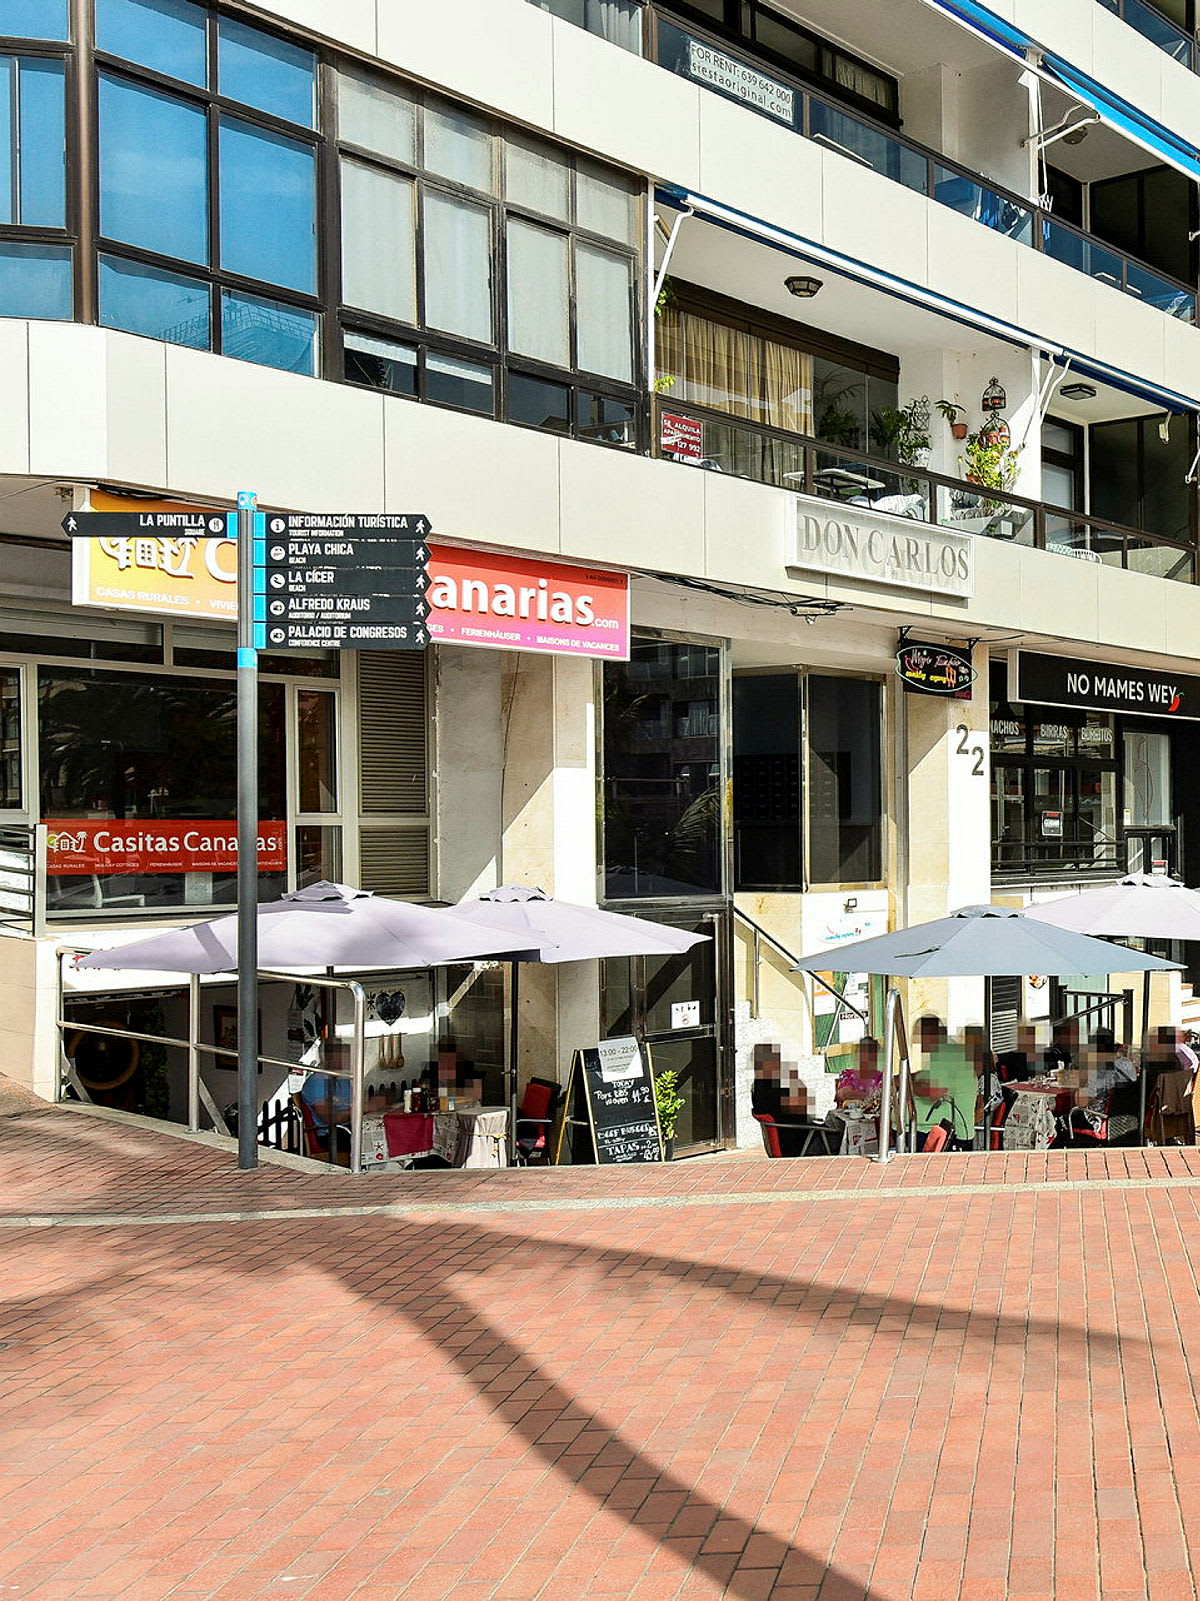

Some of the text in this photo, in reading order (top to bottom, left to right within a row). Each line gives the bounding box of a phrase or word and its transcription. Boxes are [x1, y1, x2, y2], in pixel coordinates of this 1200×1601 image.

[691, 44, 790, 104] FOR RENT: 639 642 000
[692, 61, 791, 117] siestaoriginal.com
[140, 514, 205, 527] LA PUNTILLA
[288, 513, 408, 529] INFORMACIÓN TURÍSTICA
[288, 543, 354, 555] PLAYA CHICA
[802, 514, 968, 580] DON CARLOS
[288, 569, 335, 583] LA CÍCER
[95, 586, 238, 611] CASAS RURALES VIVIE
[288, 599, 370, 610] ALFREDO KRAUS
[428, 574, 619, 629] anarias.com
[288, 626, 407, 639] PALACIO DE CONGRESOS
[461, 627, 520, 641] FERIENHÄUSER
[570, 640, 582, 648] DE
[1067, 673, 1177, 704] NO MAMES WEY
[1040, 723, 1068, 740] BIRRAS
[1081, 727, 1113, 743] BURRITOS
[93, 831, 277, 853] Casitas Canaas
[606, 1141, 640, 1156] TAPAS
